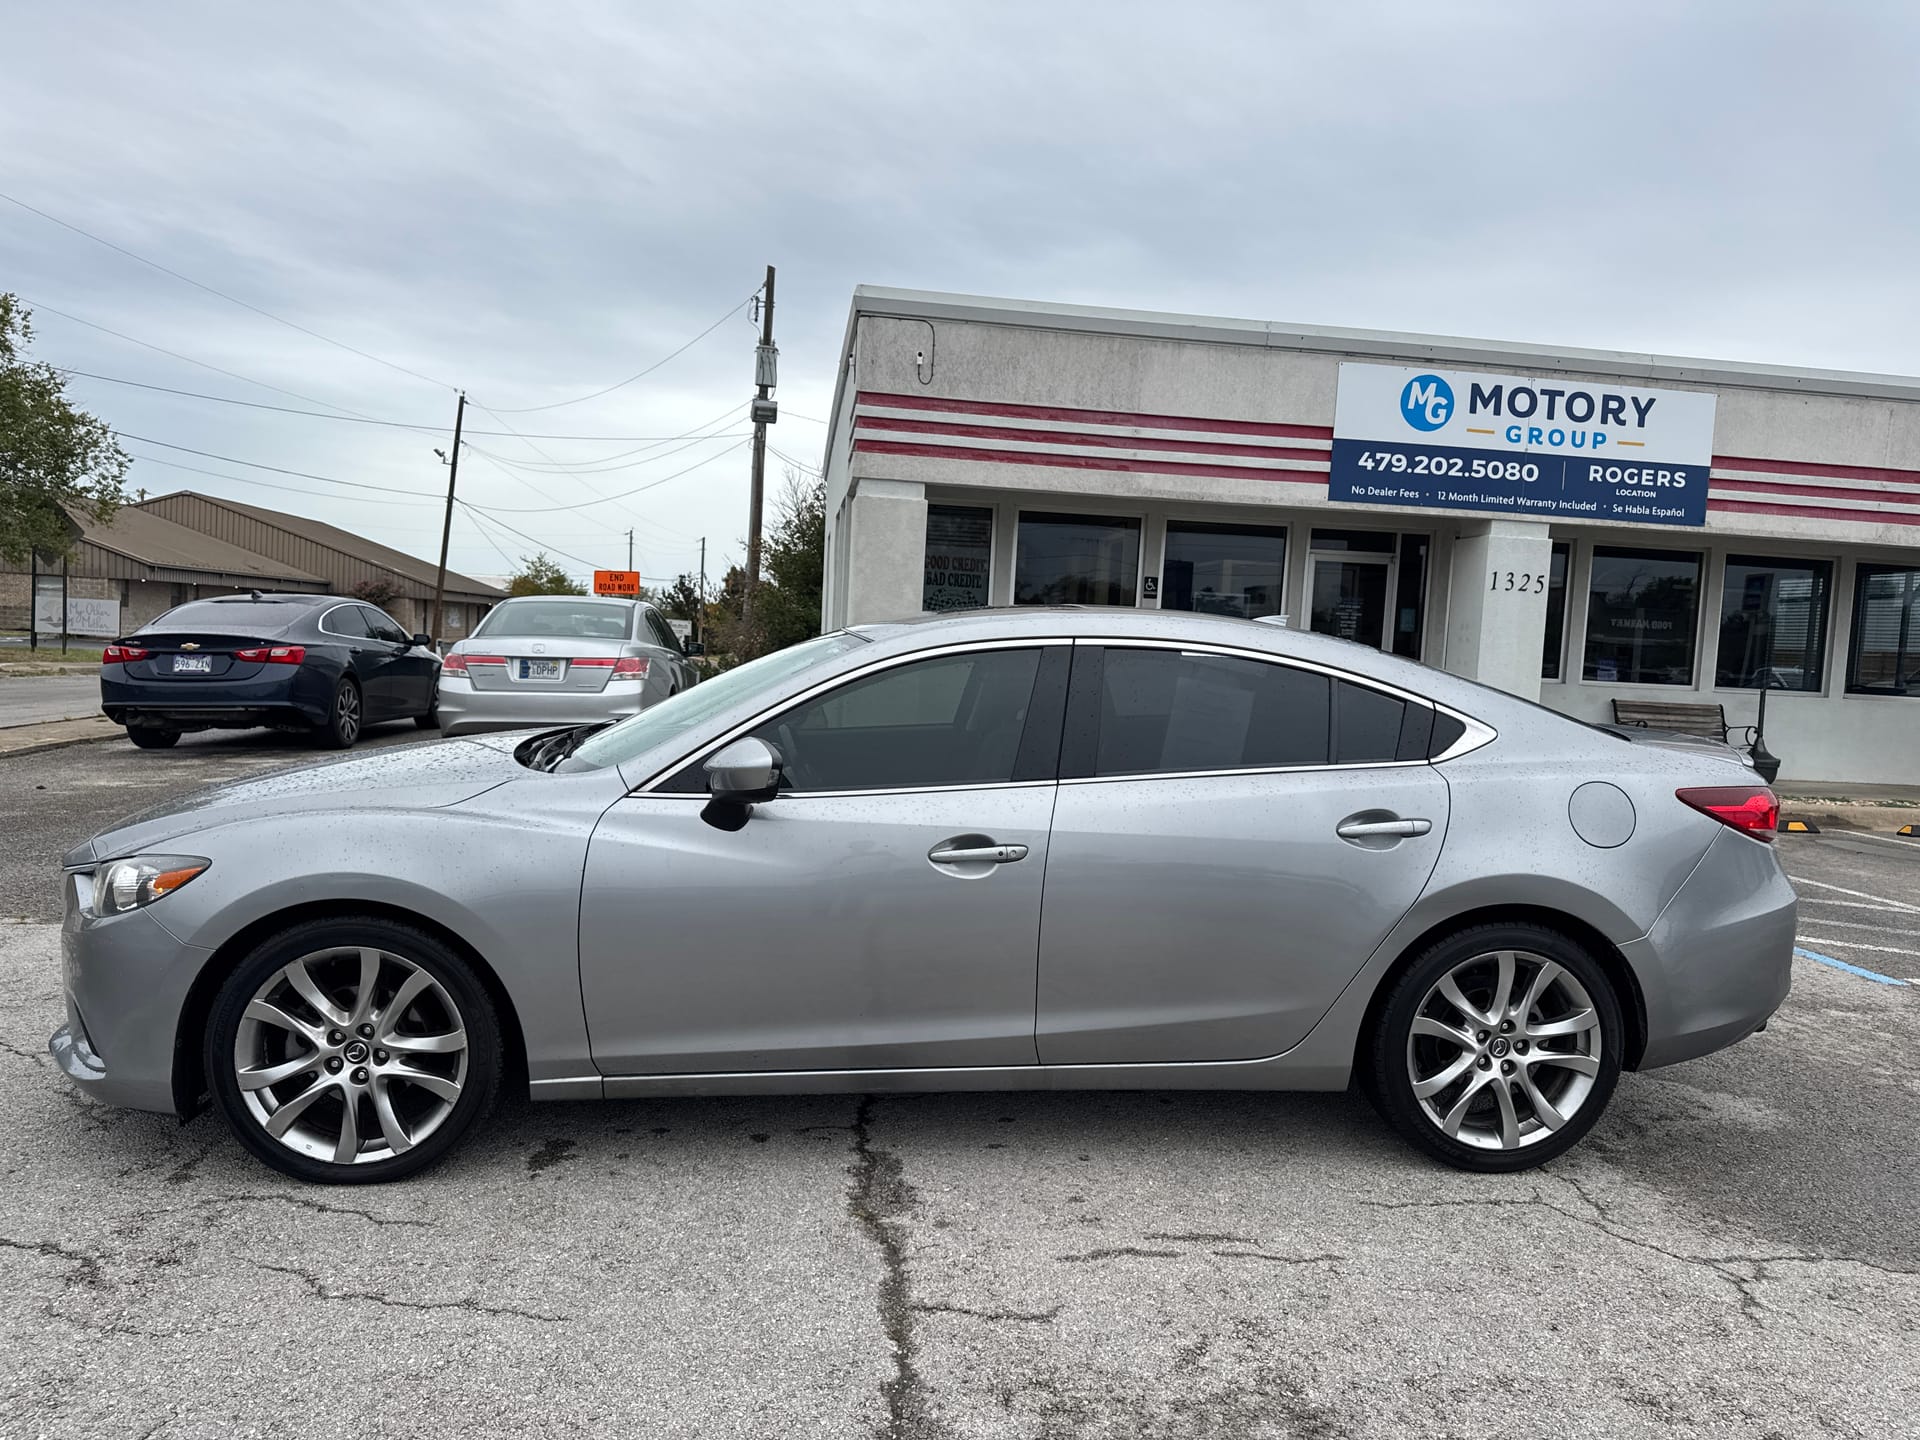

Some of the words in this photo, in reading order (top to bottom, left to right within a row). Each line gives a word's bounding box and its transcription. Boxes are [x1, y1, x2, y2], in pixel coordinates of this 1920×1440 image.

[1407, 381, 1448, 425] MG
[1469, 383, 1656, 428] MOTORY
[1505, 425, 1607, 449] GROUP
[1358, 451, 1539, 482] 479.202.5080
[1589, 465, 1686, 488] ROGERS
[1351, 485, 1366, 495] No
[1367, 486, 1398, 497] Dealer
[1399, 488, 1419, 498] Fees
[1437, 491, 1447, 500] 12
[1448, 492, 1479, 503] Month
[1480, 494, 1514, 505] Limited
[1516, 497, 1557, 510] Warranty
[1559, 500, 1597, 511] Included
[1612, 504, 1622, 513] Se
[1625, 505, 1650, 515] Habla
[1652, 506, 1685, 518] Español
[1616, 488, 1657, 498] LOCATION
[598, 583, 615, 592] ROAD
[618, 583, 635, 592] WORK
[609, 573, 624, 582] END
[926, 571, 946, 586] BAD
[1490, 571, 1545, 594] 1325
